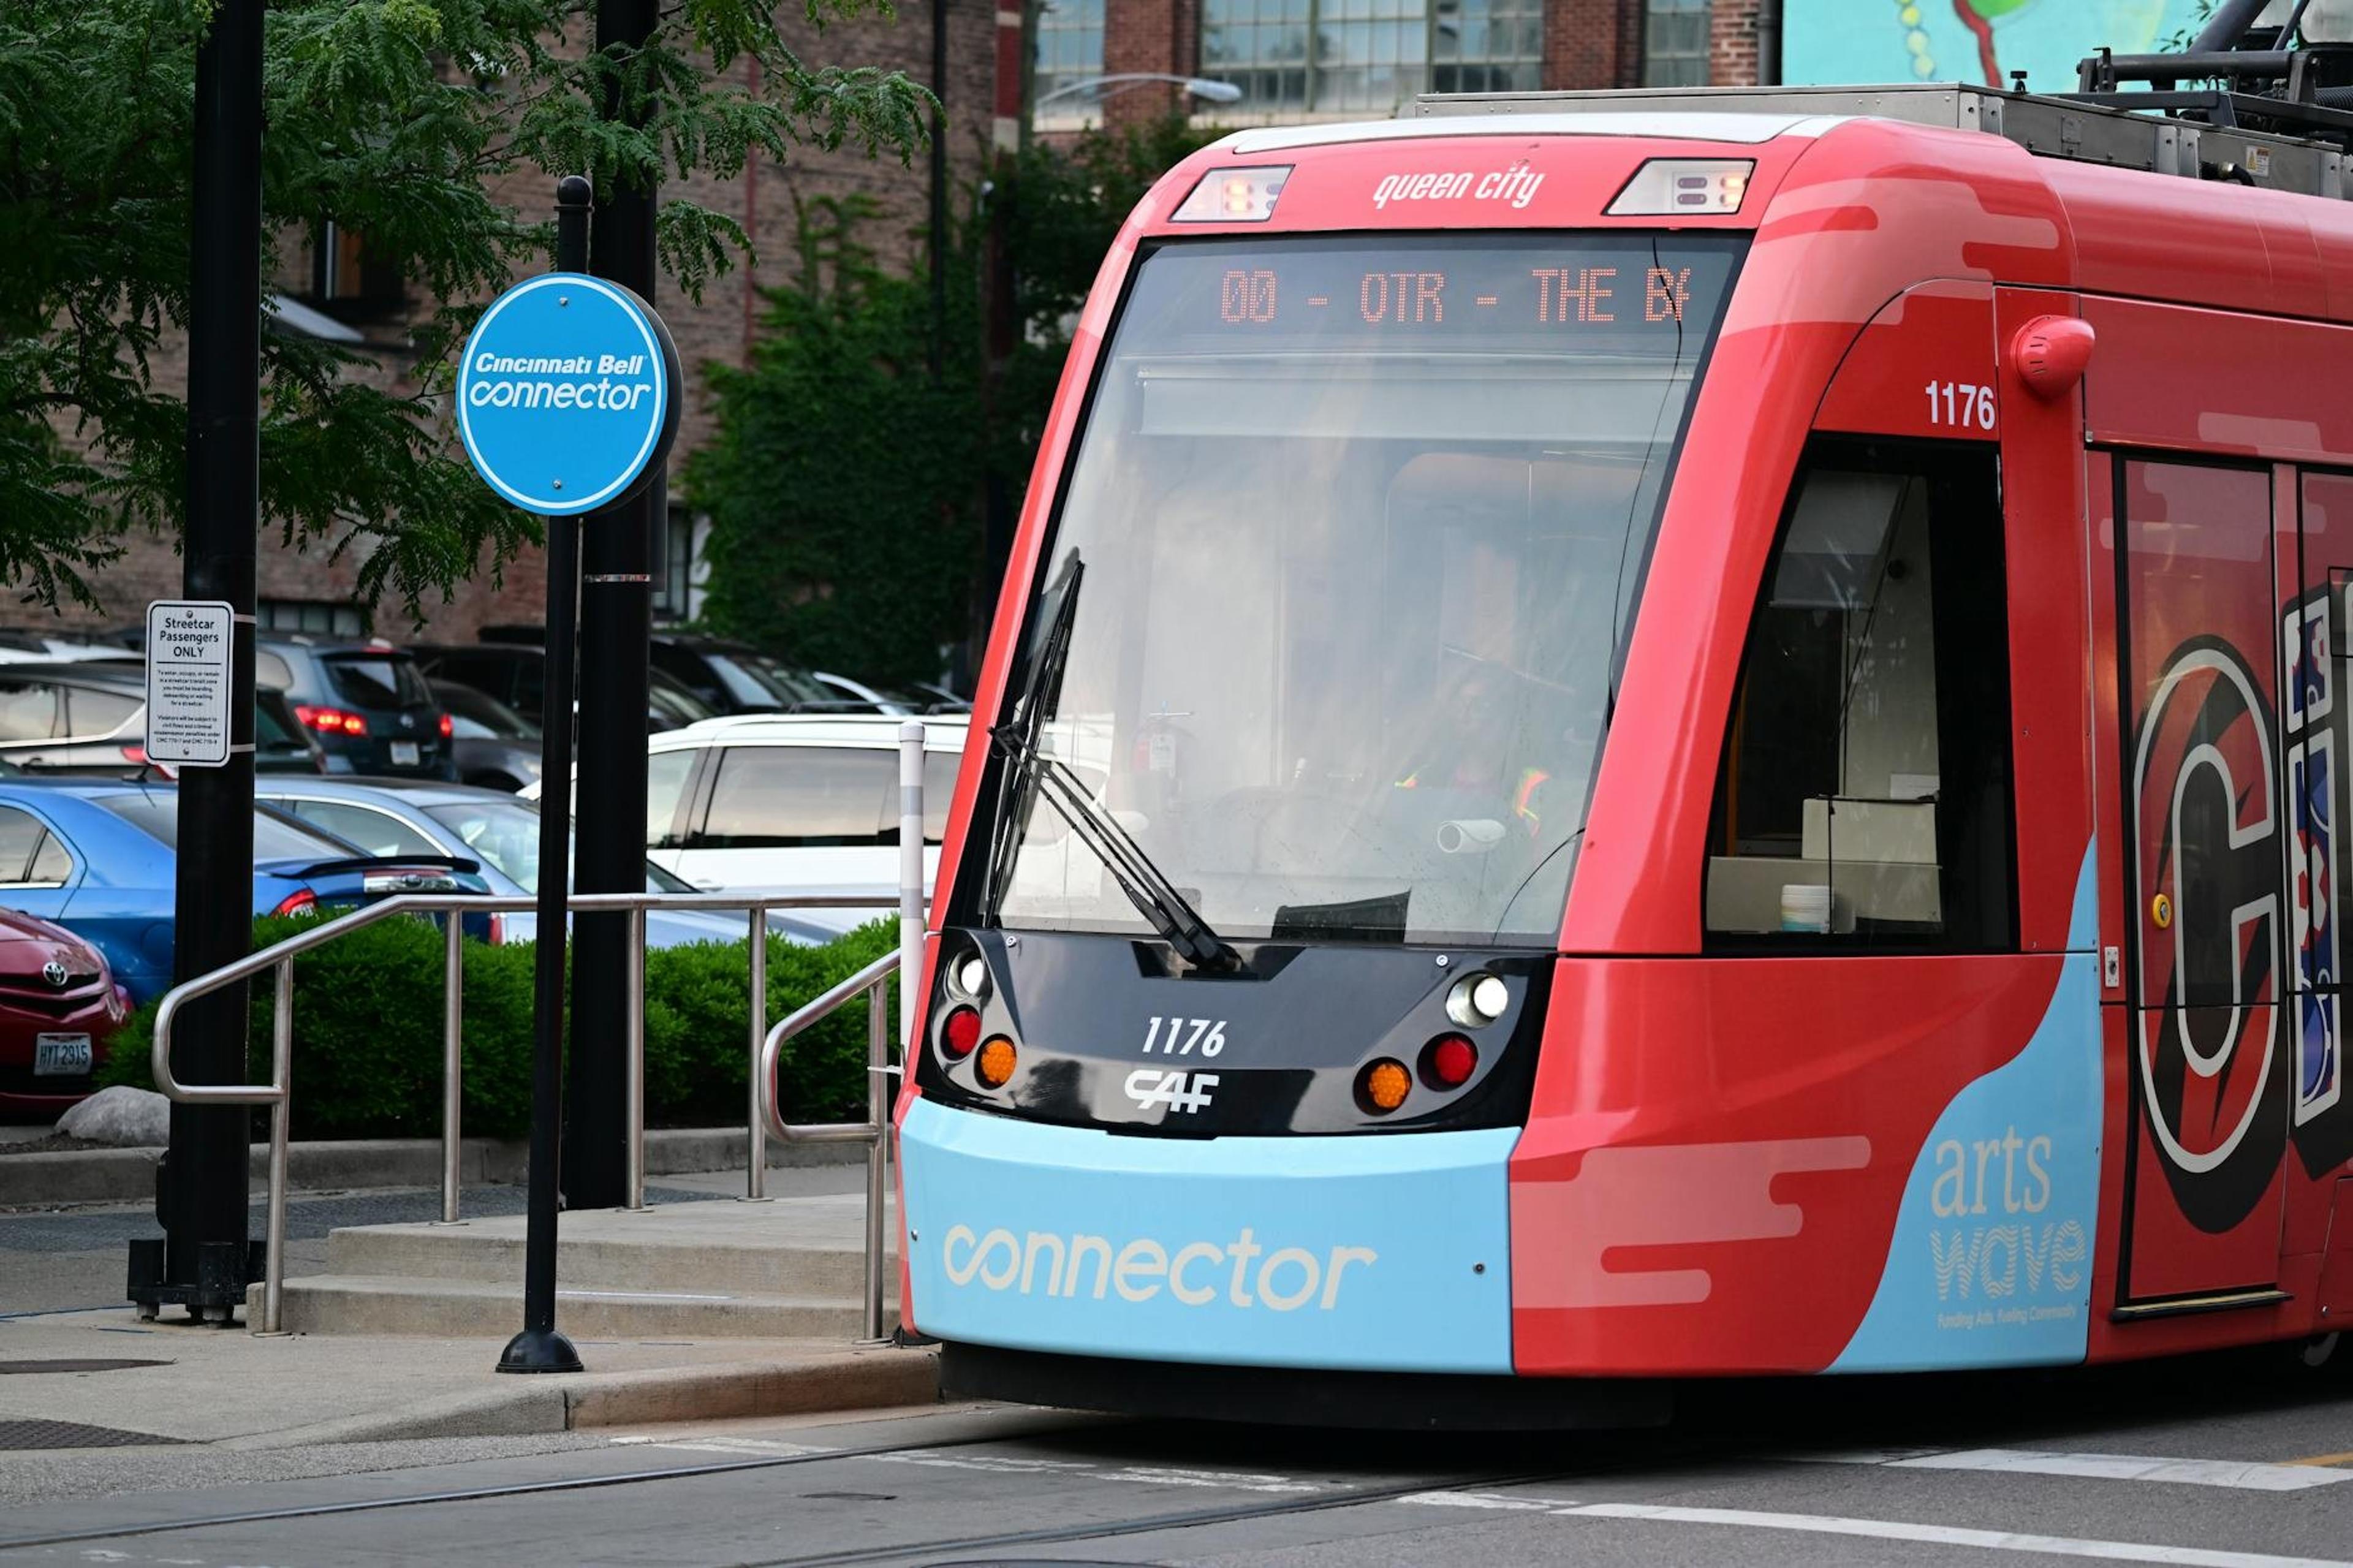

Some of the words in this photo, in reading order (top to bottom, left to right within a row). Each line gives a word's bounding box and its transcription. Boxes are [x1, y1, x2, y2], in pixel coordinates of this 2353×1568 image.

[1373, 172, 1472, 210] queen
[1474, 166, 1544, 209] city
[1221, 270, 1275, 322] 00
[1361, 273, 1444, 322] OTR
[1532, 268, 1616, 322] THE
[476, 352, 592, 374] Cincinnati
[597, 355, 643, 374] Bell
[470, 378, 651, 411] connector
[1927, 381, 1995, 430] 1176
[160, 631, 219, 645] Passengers
[165, 618, 214, 629] Streetcar
[173, 646, 204, 657] ONLY
[40, 1045, 59, 1066] HYT
[61, 1045, 88, 1066] 2915
[1142, 1017, 1226, 1057] 1176
[1124, 1069, 1219, 1113] CAF
[1931, 1125, 2052, 1218] arts
[943, 1224, 1377, 1311] connector
[1930, 1220, 2086, 1301] wave
